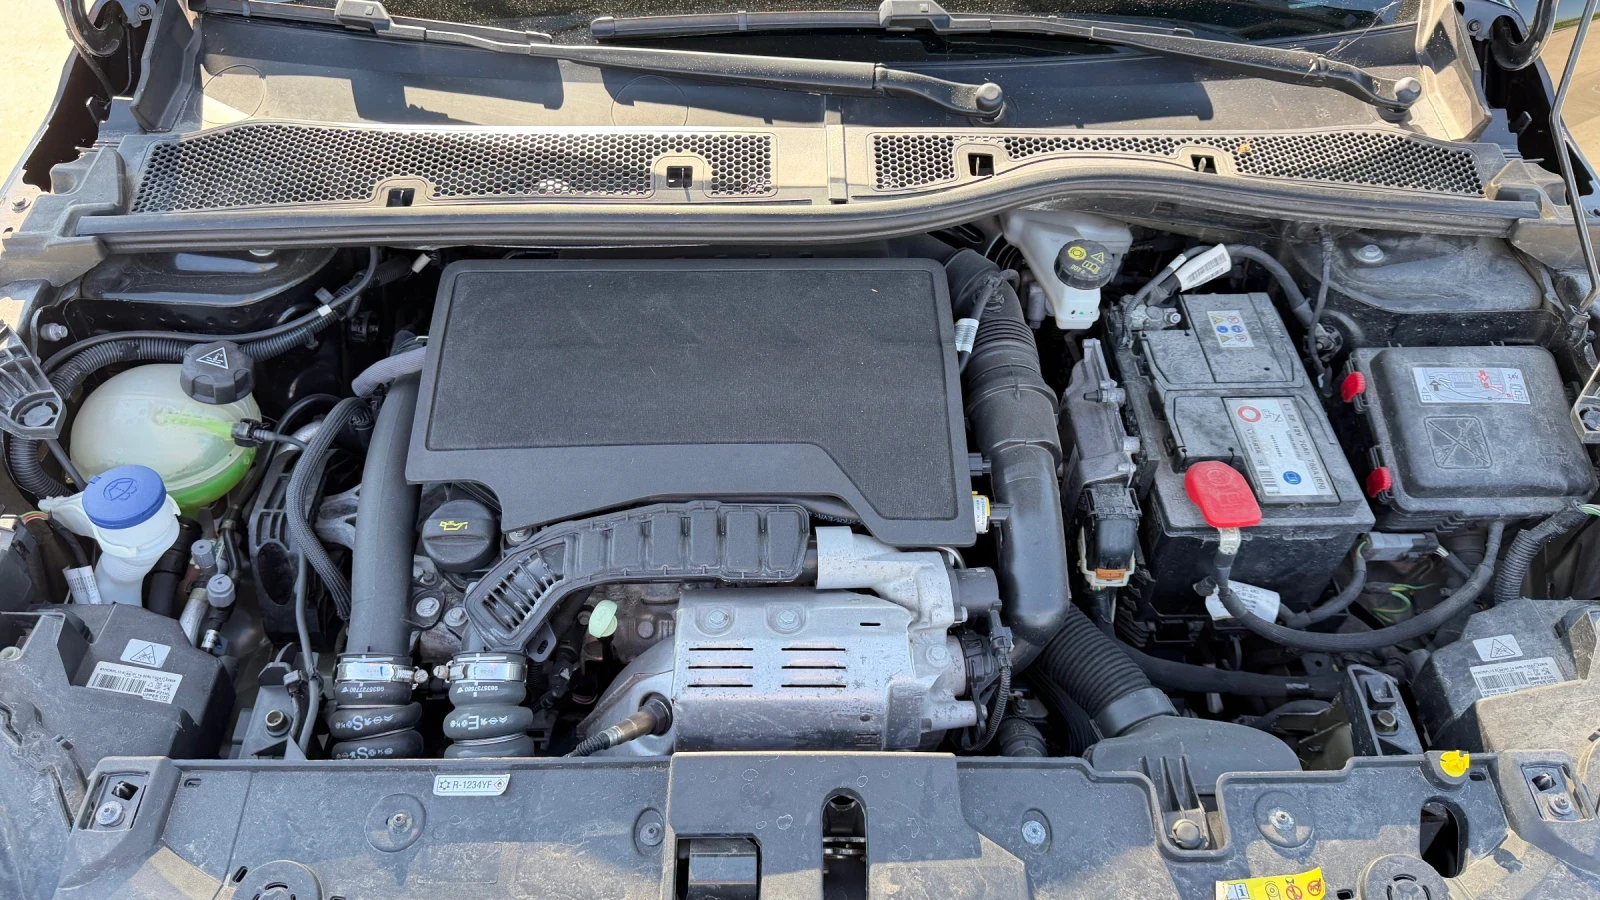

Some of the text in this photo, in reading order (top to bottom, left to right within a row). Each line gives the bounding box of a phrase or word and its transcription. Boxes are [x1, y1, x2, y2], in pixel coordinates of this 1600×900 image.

[1070, 264, 1082, 272] DOT
[352, 715, 363, 731] S
[452, 780, 493, 790] R-1234YF
